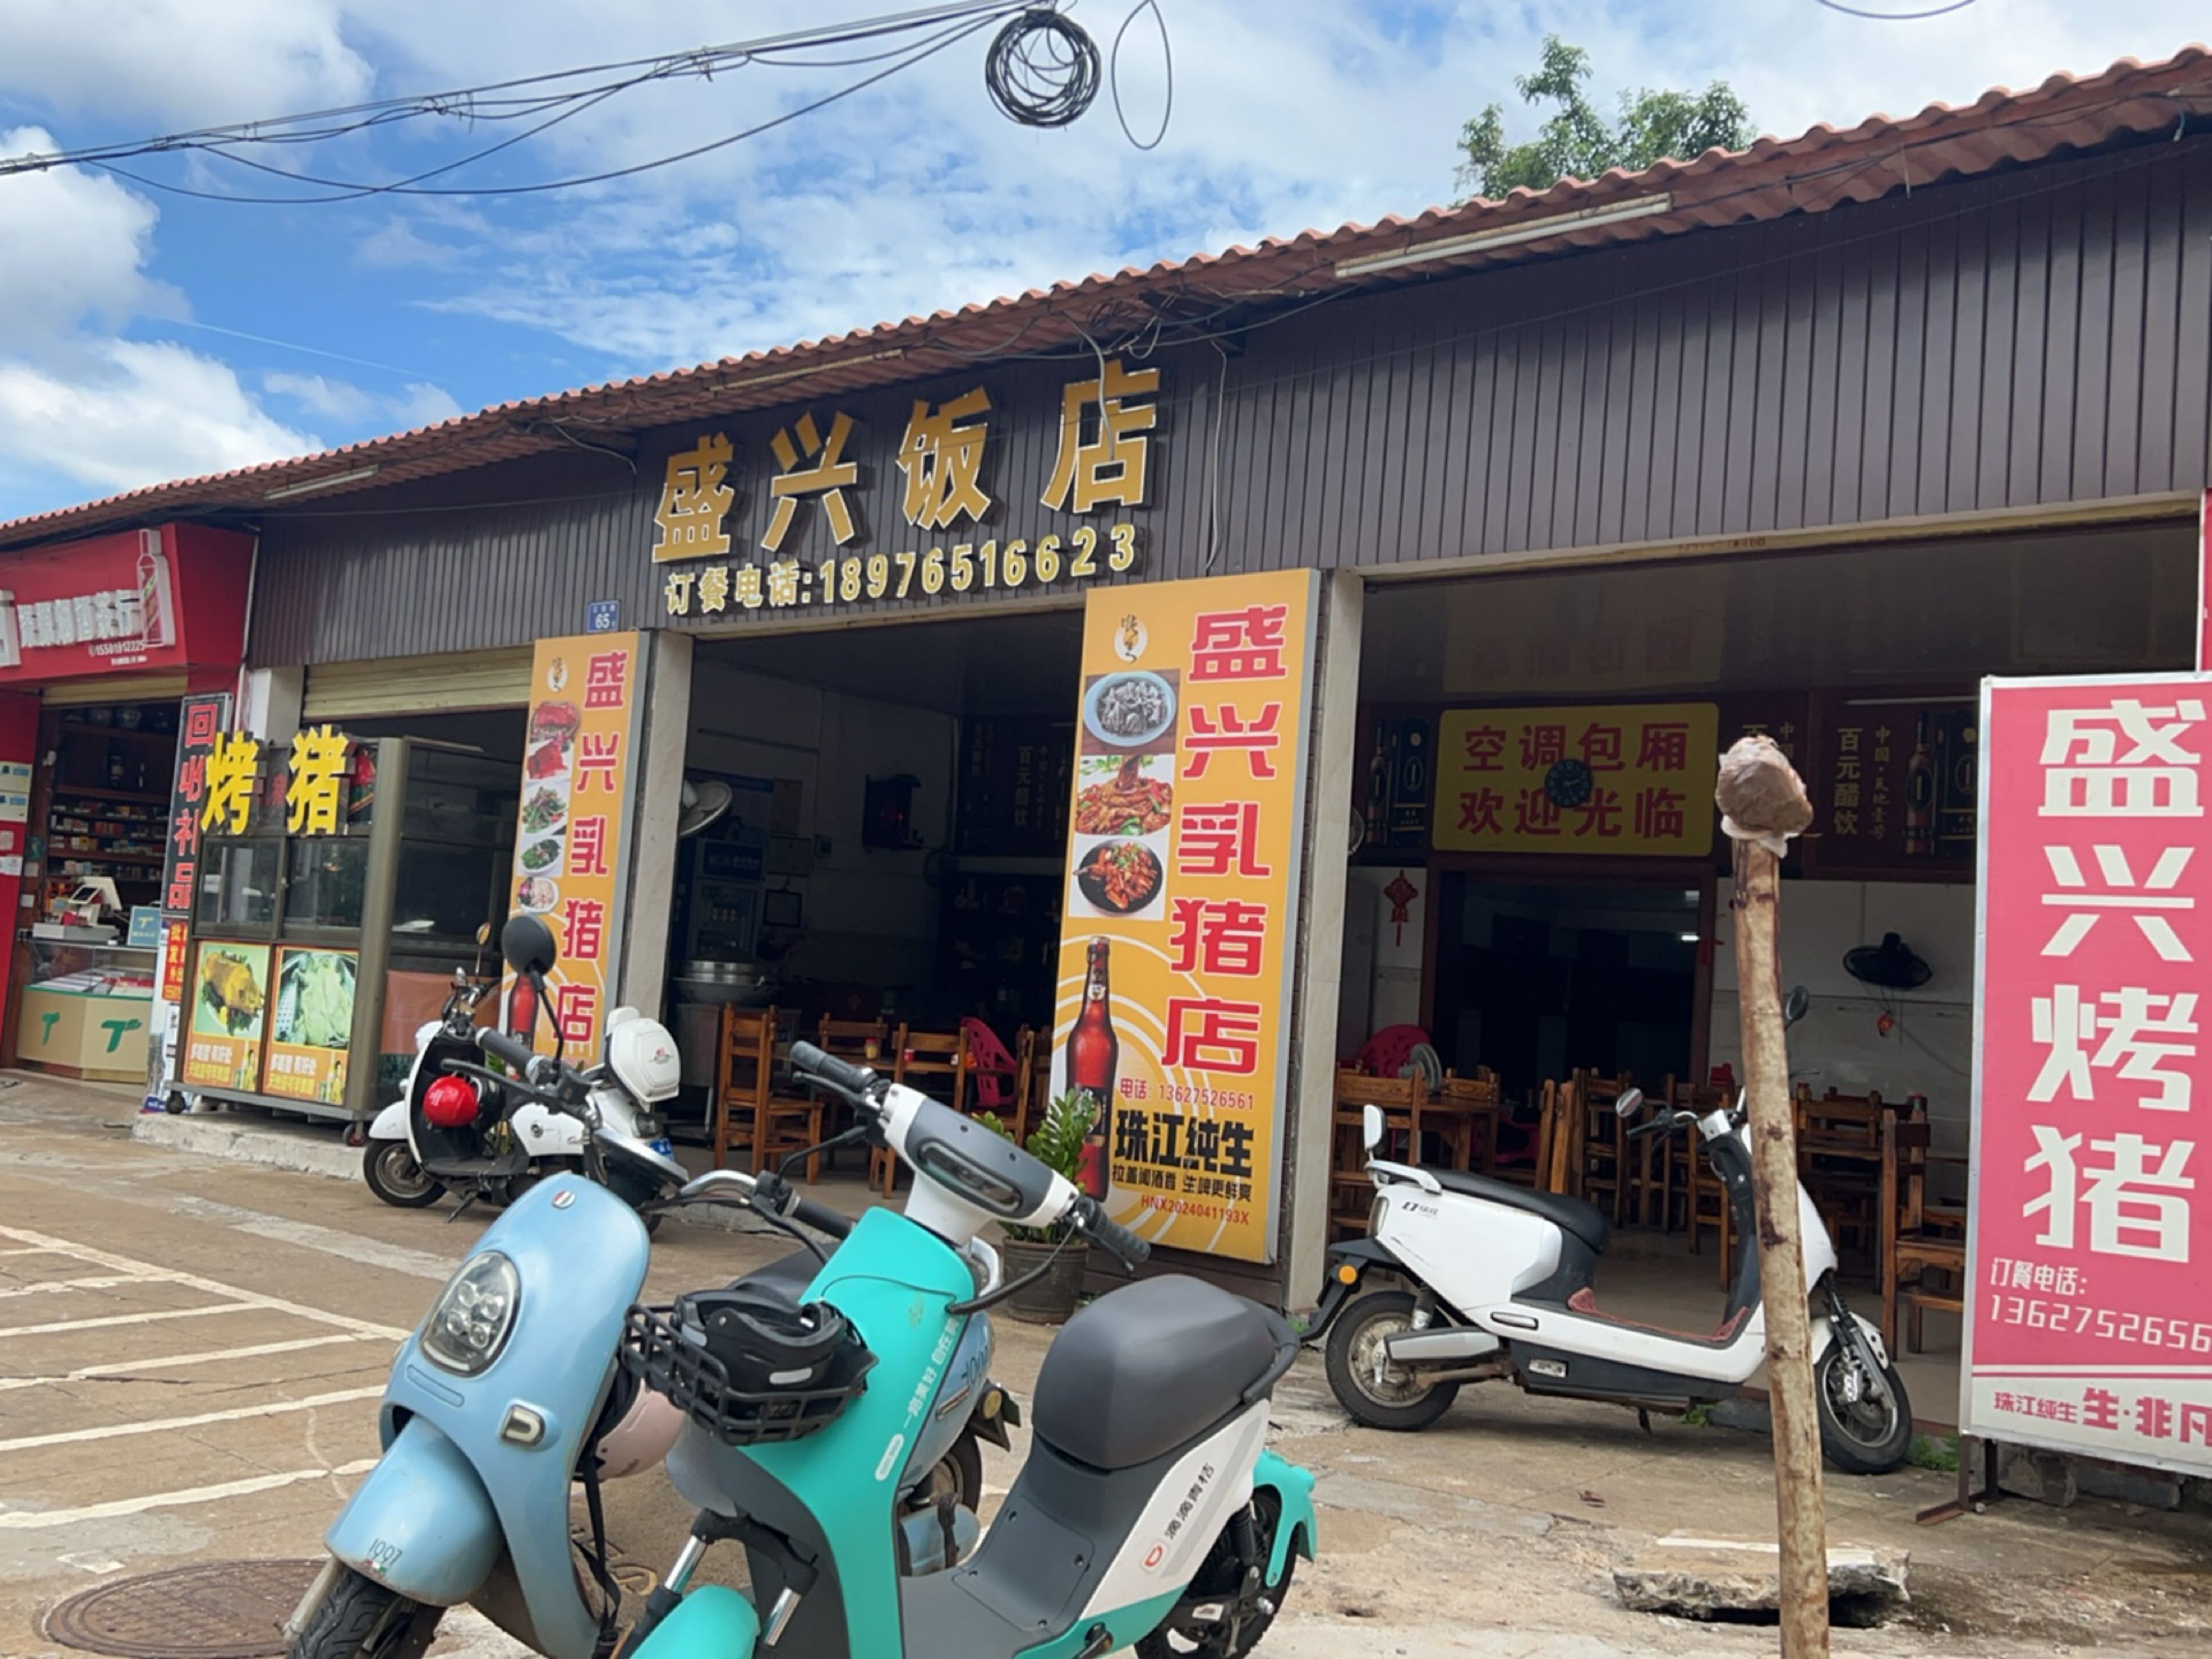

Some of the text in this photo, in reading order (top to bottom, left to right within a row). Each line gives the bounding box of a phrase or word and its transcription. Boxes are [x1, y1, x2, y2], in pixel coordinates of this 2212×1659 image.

[653, 360, 1160, 563] 盛兴饭店
[1464, 721, 1690, 773] 空调包厢
[200, 724, 350, 837] 烤猪
[1834, 727, 1863, 836] 百元醋饮
[1160, 603, 1288, 1076] 盛兴乳猪店
[1457, 787, 1688, 840] 欢迎光临
[552, 650, 628, 1045] 盛兴乳猪店
[2023, 699, 2207, 1263] 盛兴烤猪
[1159, 1084, 1254, 1110] 13627526561
[1114, 1109, 1254, 1178] 珠江纯生
[1141, 1194, 1250, 1225] HNX2024041193X
[1991, 1257, 2087, 1296] 订餐电话:
[1991, 1294, 2212, 1352] 1362752656
[1994, 1391, 2078, 1423] 珠江纯生
[368, 1538, 403, 1567] 1997
